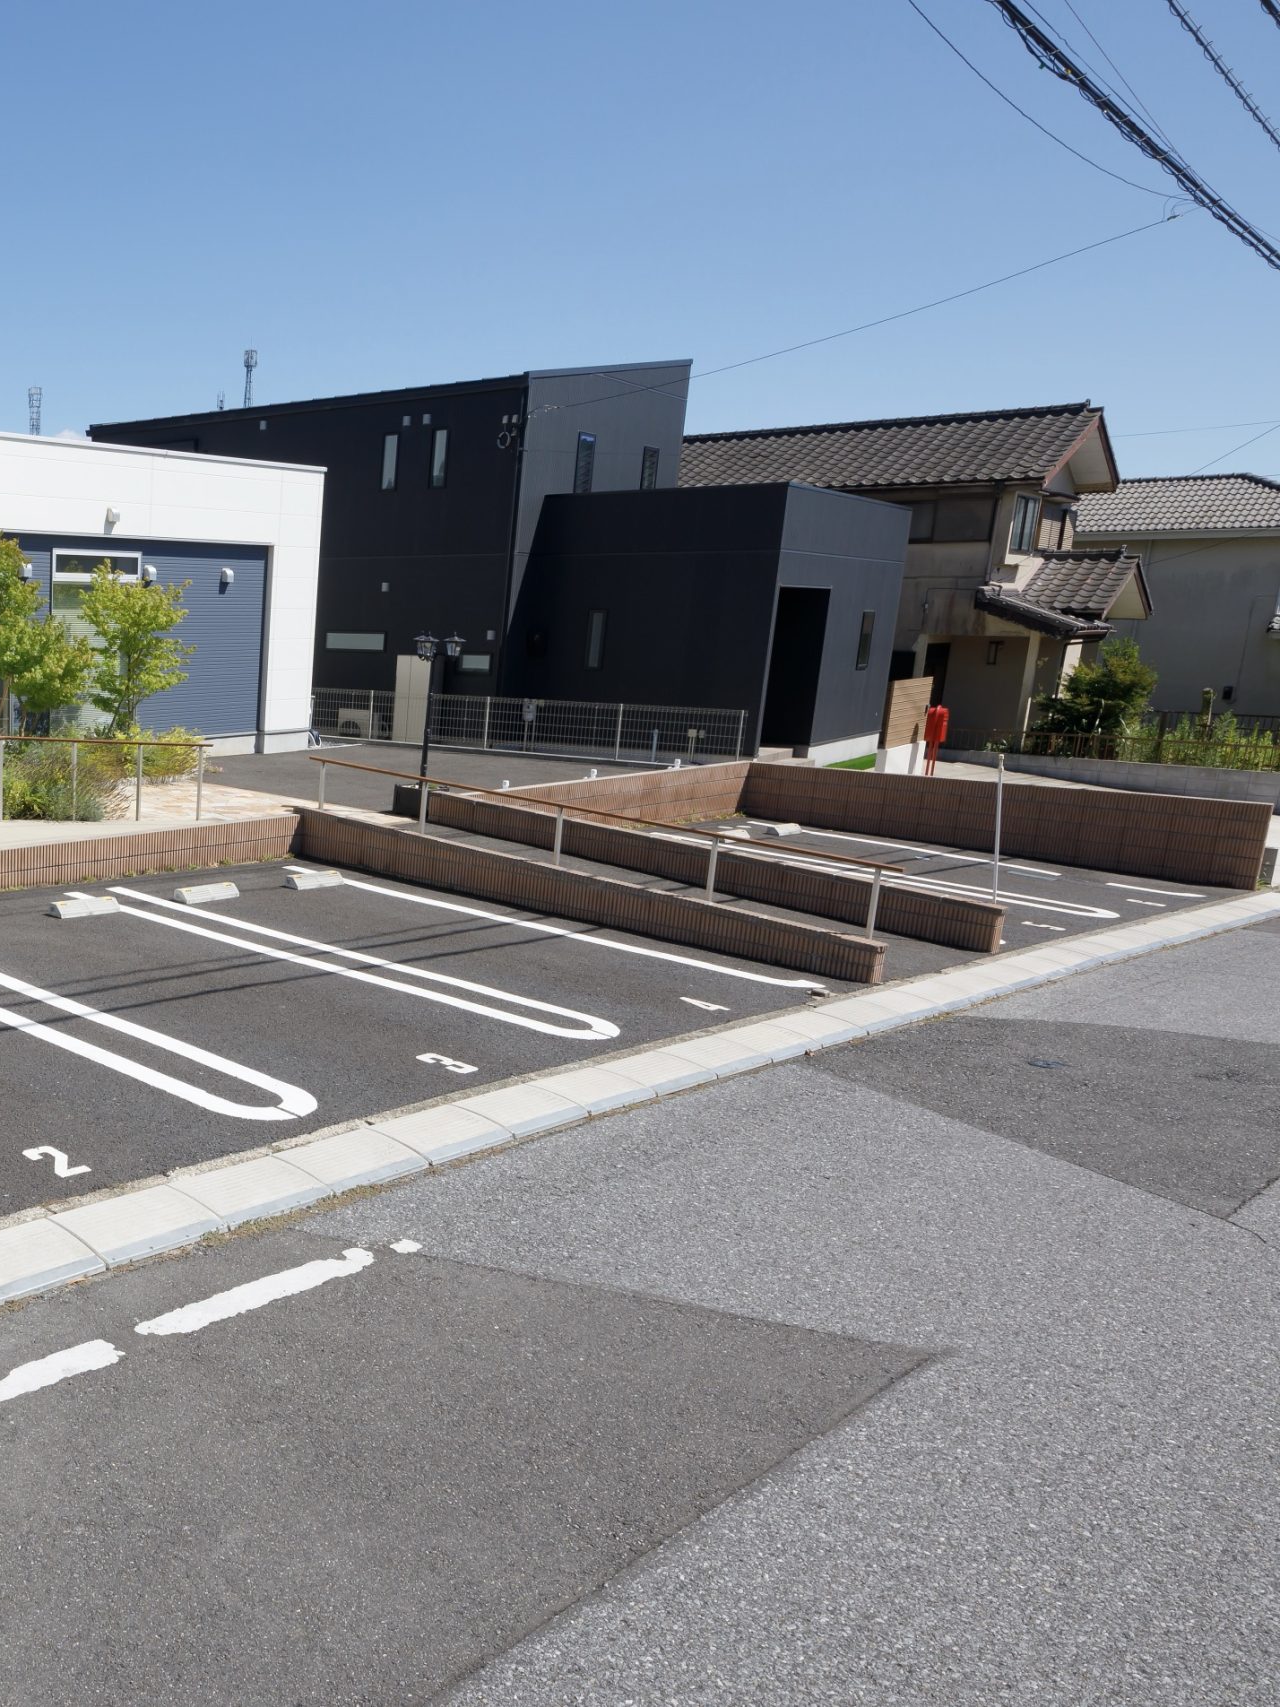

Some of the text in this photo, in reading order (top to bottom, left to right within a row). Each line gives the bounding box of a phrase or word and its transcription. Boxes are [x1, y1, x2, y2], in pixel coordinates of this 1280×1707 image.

[679, 996, 730, 1011] 4
[416, 1052, 479, 1074] 3
[21, 1145, 92, 1178] 2
